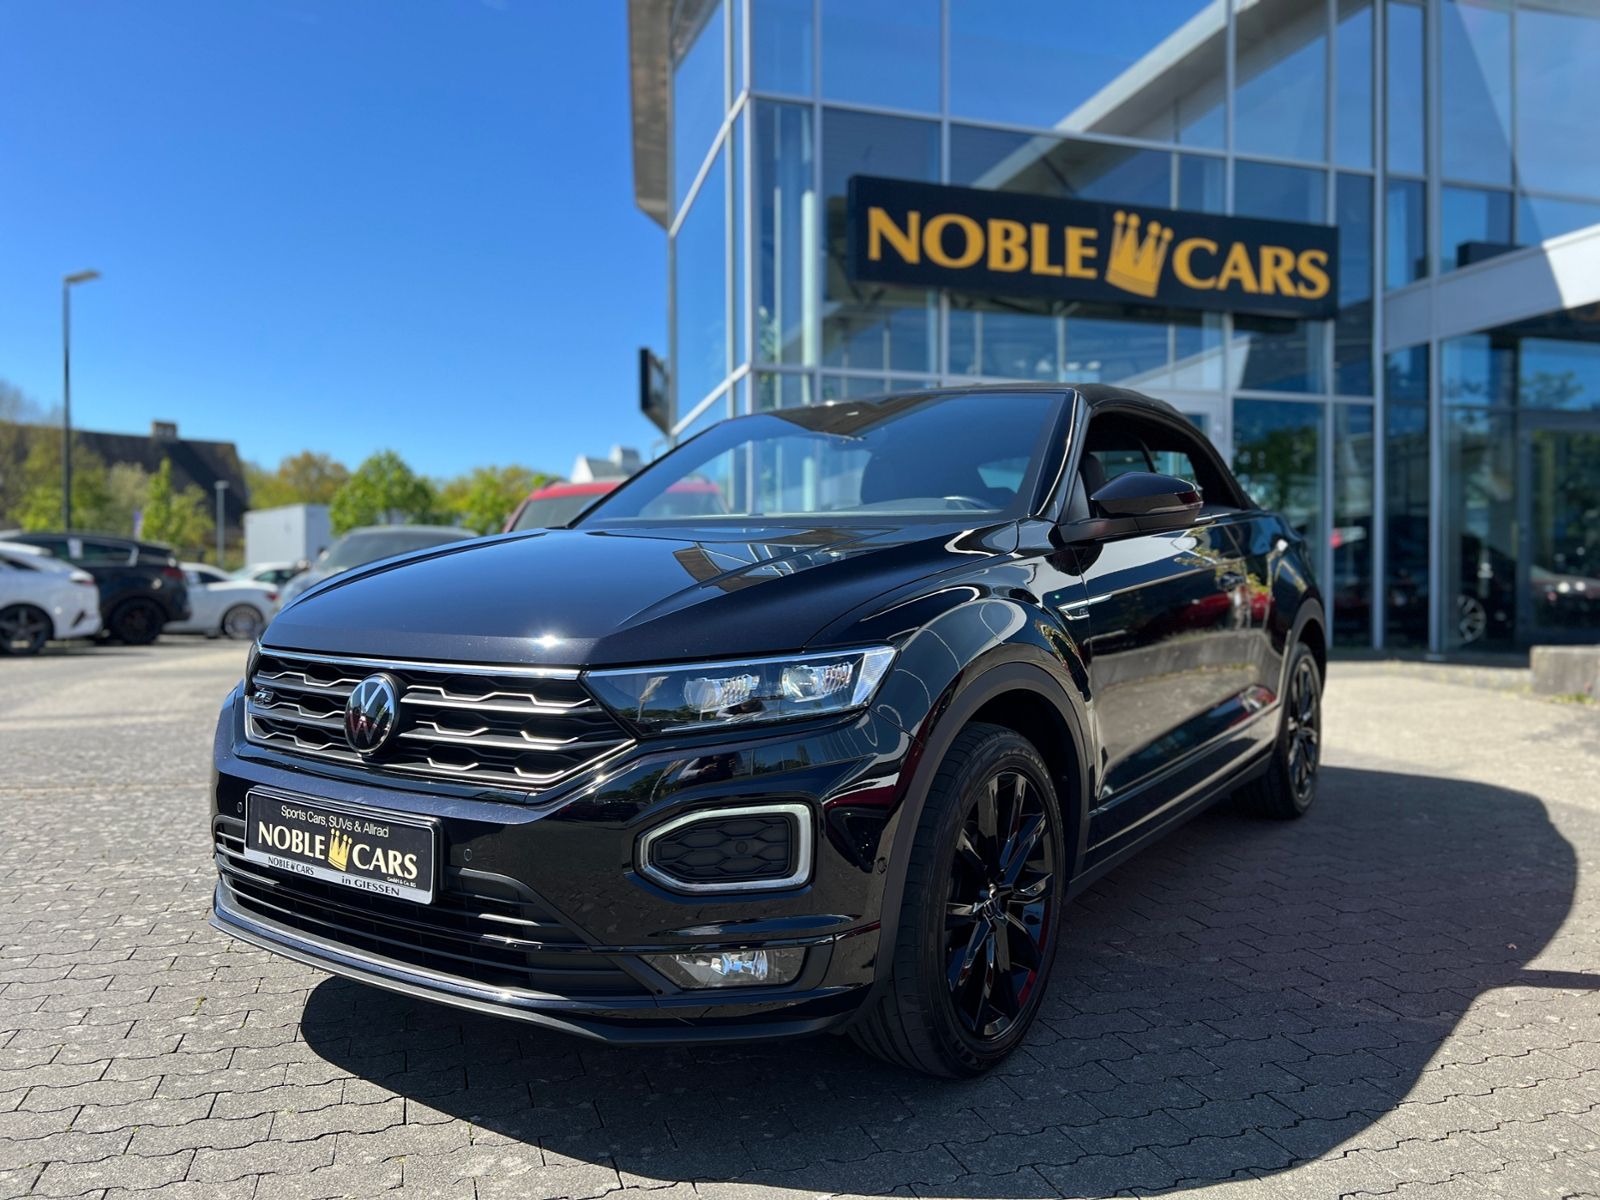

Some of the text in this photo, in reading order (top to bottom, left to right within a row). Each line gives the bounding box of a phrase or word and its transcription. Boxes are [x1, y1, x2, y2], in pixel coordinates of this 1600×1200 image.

[867, 206, 1330, 301] NOBLE CARS
[281, 805, 389, 838] Sports Cars, SUVs & Allrad
[258, 821, 418, 880] NOBLE CARS
[268, 856, 314, 876] NOBLE CARS
[341, 875, 400, 896] in GIESSEN
